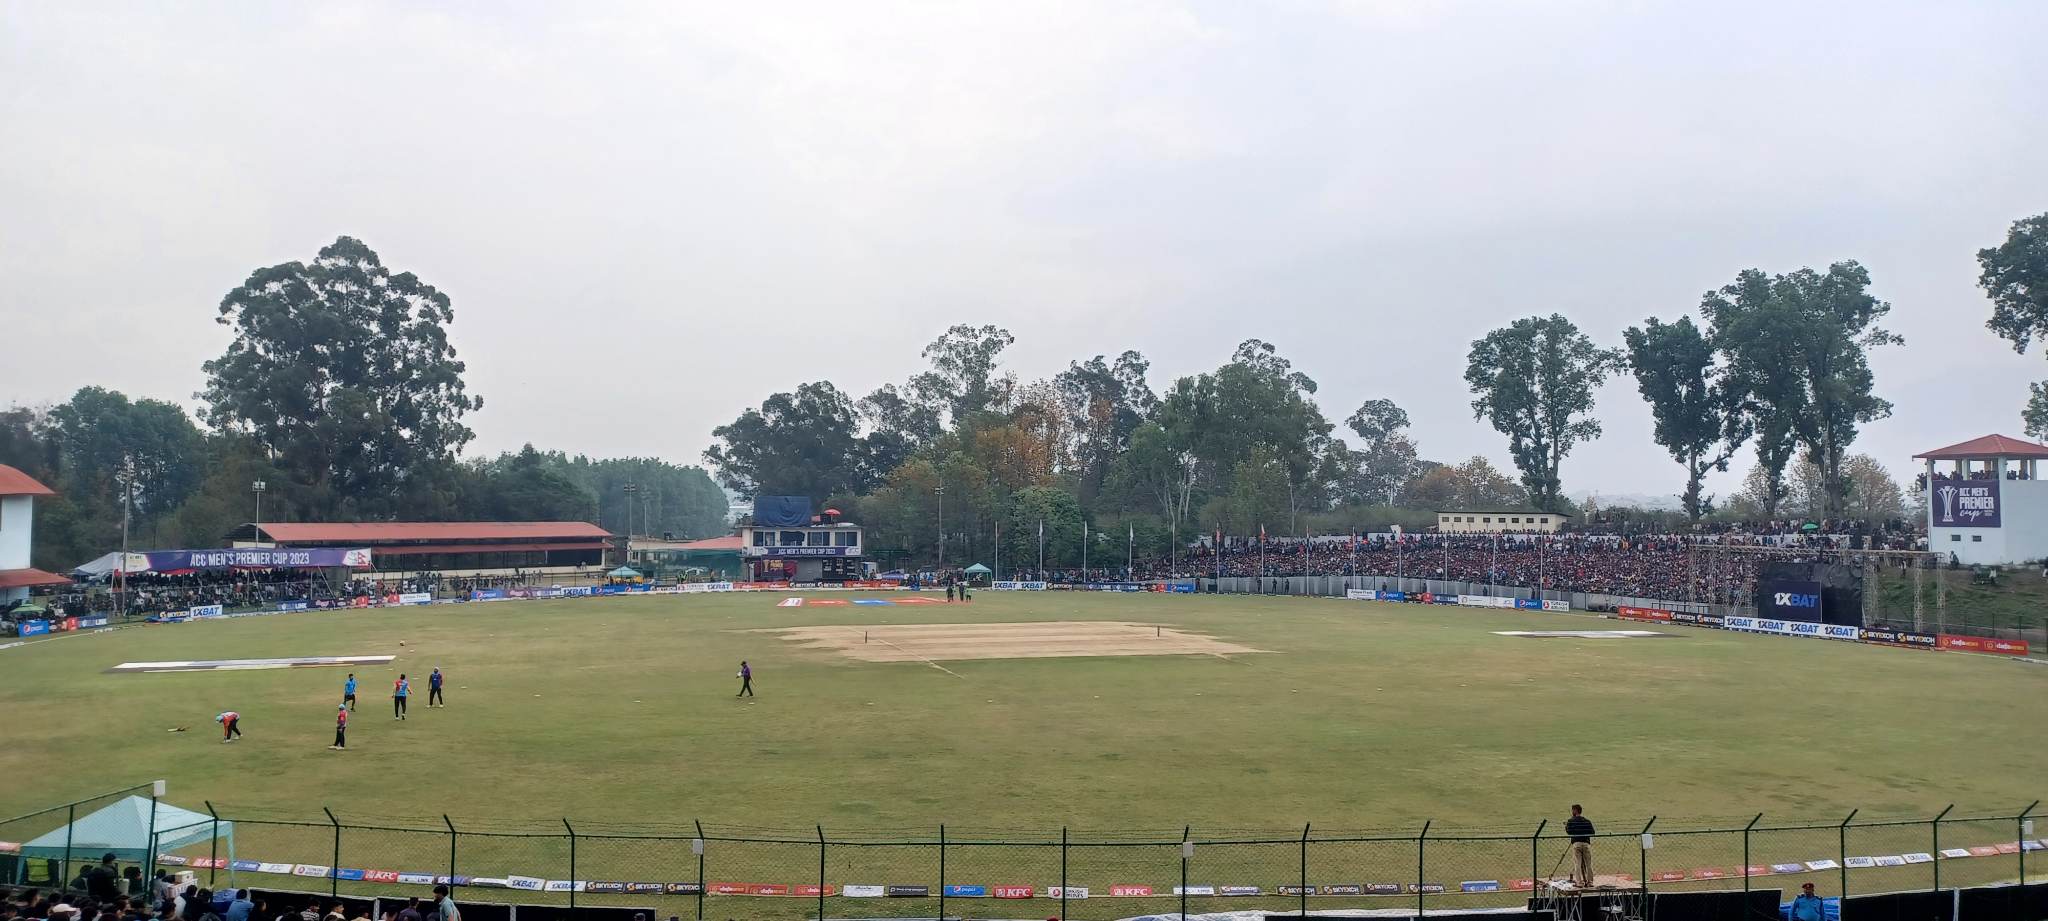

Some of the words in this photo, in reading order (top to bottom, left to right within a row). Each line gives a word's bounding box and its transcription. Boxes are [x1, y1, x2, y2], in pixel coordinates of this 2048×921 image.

[1959, 487, 1970, 497] ACC
[1971, 487, 1989, 497] MEN'S
[1959, 496, 1994, 510] PREMIER
[1959, 509, 1983, 523] cup
[190, 553, 206, 567] ACC
[208, 552, 234, 566] MEN'S
[235, 551, 270, 565] PREMIER
[272, 551, 288, 565] CUP
[289, 551, 310, 565] 2023
[1774, 592, 1819, 608] 1XBAT
[192, 606, 220, 617] 1XBAT
[1726, 618, 1753, 627] 1XBAT
[1757, 620, 1785, 631] 1XBAT
[1790, 623, 1820, 634] 1XBAT
[1824, 626, 1856, 638] 1XBAT
[376, 871, 397, 880] KFC
[511, 879, 538, 889] 1XBAT
[1006, 888, 1031, 897] KFC
[1125, 888, 1148, 896] KFC
